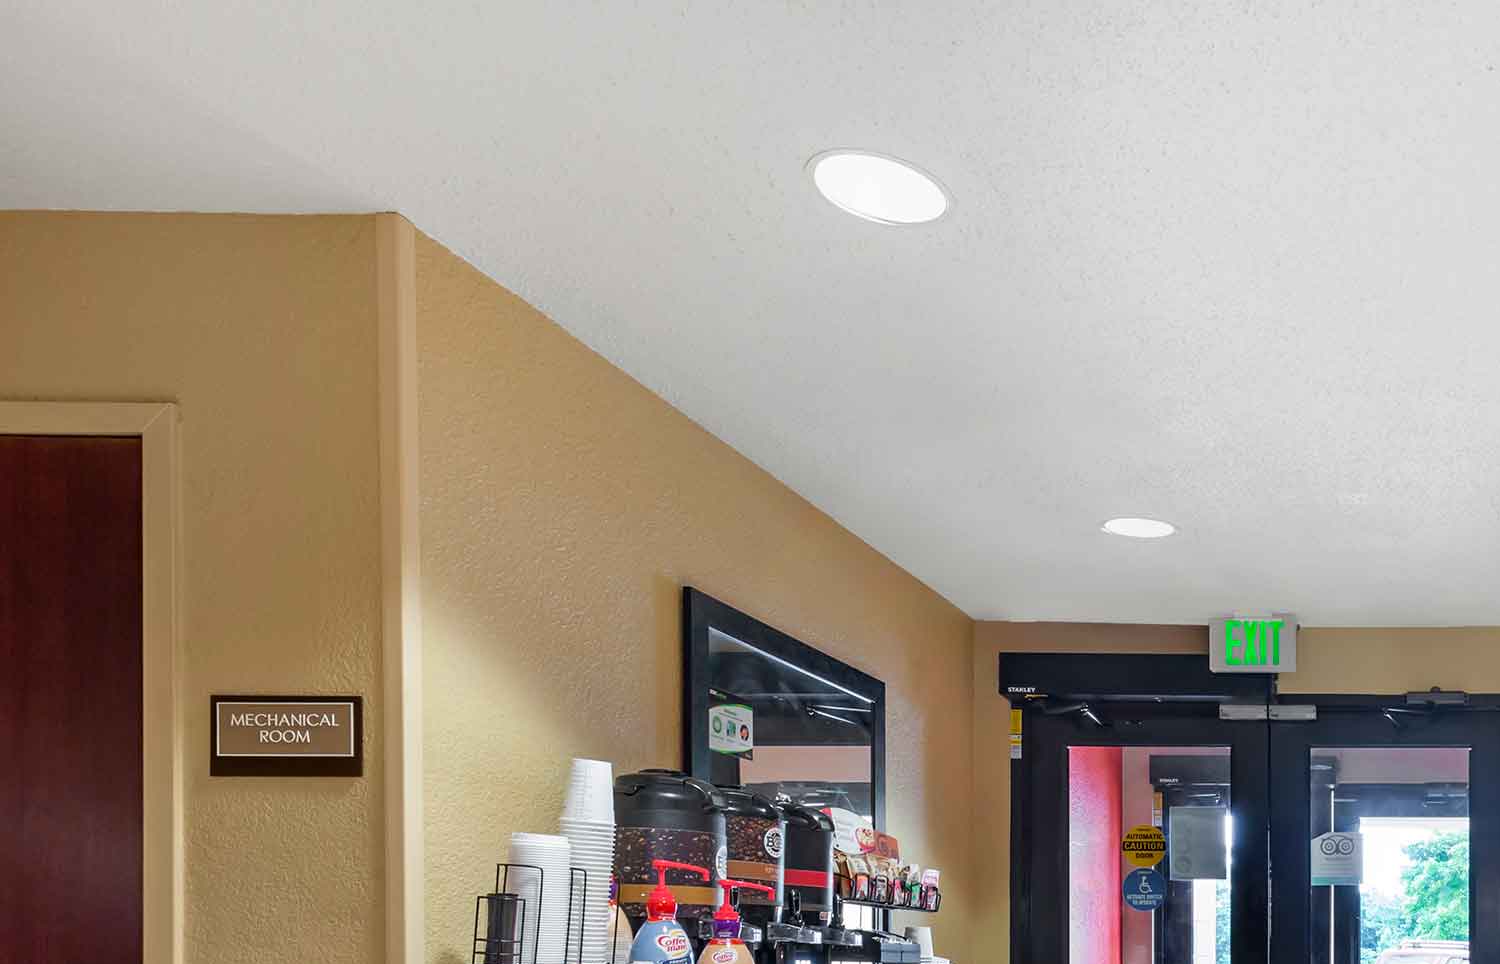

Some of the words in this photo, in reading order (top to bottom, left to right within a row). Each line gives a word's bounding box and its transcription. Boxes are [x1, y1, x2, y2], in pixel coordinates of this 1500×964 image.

[1225, 619, 1285, 666] EXIT
[230, 713, 340, 727] MECHANICAL
[259, 730, 311, 743] ROOM
[1124, 841, 1164, 850] CAUTION
